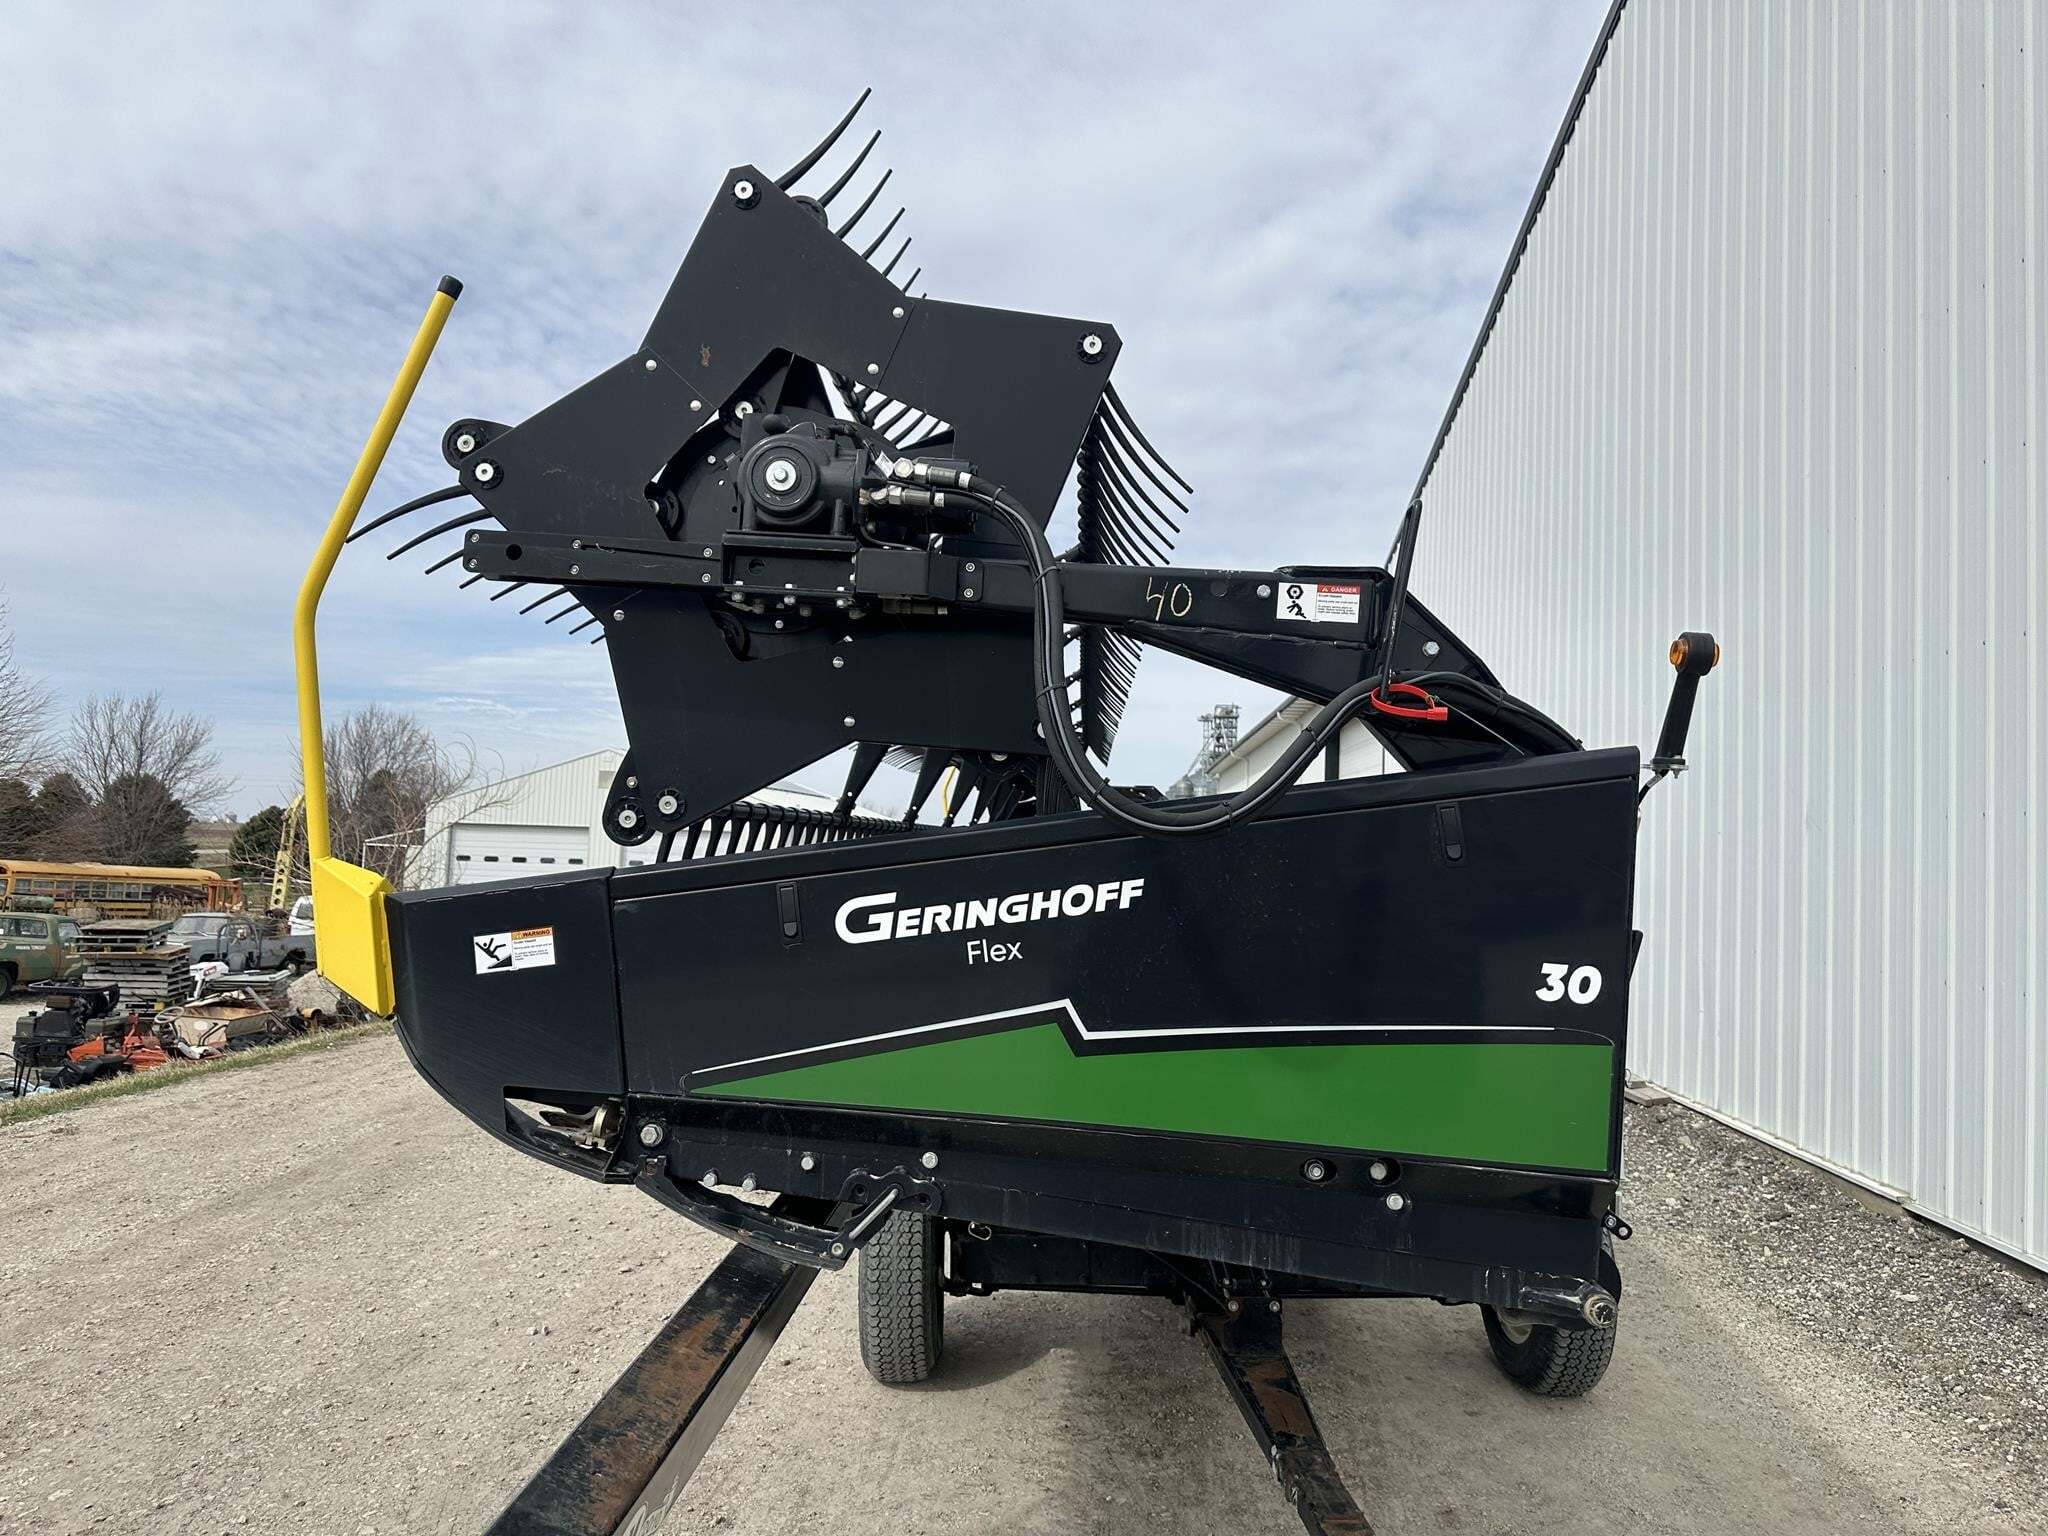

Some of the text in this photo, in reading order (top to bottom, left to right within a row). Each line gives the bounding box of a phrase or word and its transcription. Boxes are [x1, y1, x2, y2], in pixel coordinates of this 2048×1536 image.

[1146, 576, 1192, 621] 40
[834, 878, 1145, 944] GERINGHOFF
[522, 929, 551, 938] WARNING
[966, 939, 1024, 965] Flex
[1535, 962, 1603, 1005] 30
